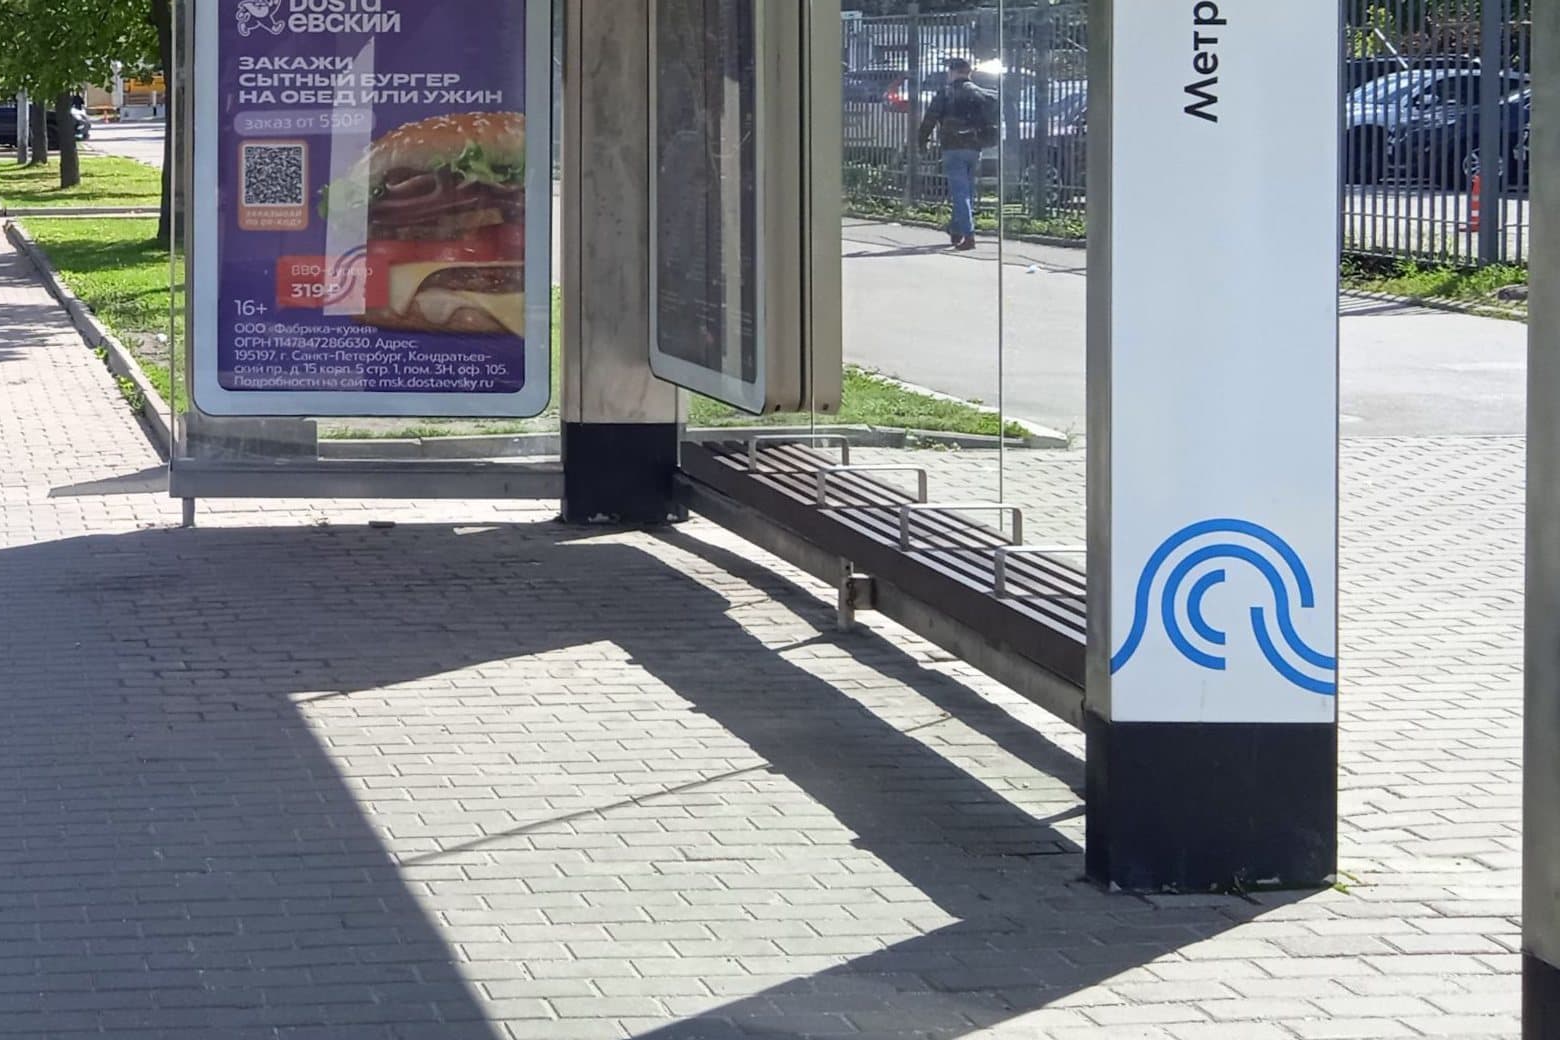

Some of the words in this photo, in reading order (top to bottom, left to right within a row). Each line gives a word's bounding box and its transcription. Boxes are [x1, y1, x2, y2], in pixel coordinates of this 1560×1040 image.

[238, 56, 354, 70] ЗАКАЖИ
[239, 70, 355, 87] СЫТНЫЙ
[360, 73, 461, 87] БУРГЕР
[239, 91, 276, 104] НА
[281, 91, 357, 107] ОБЕД
[361, 91, 420, 104] ИЛИ
[423, 91, 503, 104] УЖИН
[244, 118, 292, 131] заказ
[296, 118, 315, 129] от
[234, 300, 269, 316] 16+
[234, 323, 266, 334] ООО
[234, 337, 271, 348] ОГРН
[303, 363, 317, 374] 15
[355, 363, 364, 374] 5
